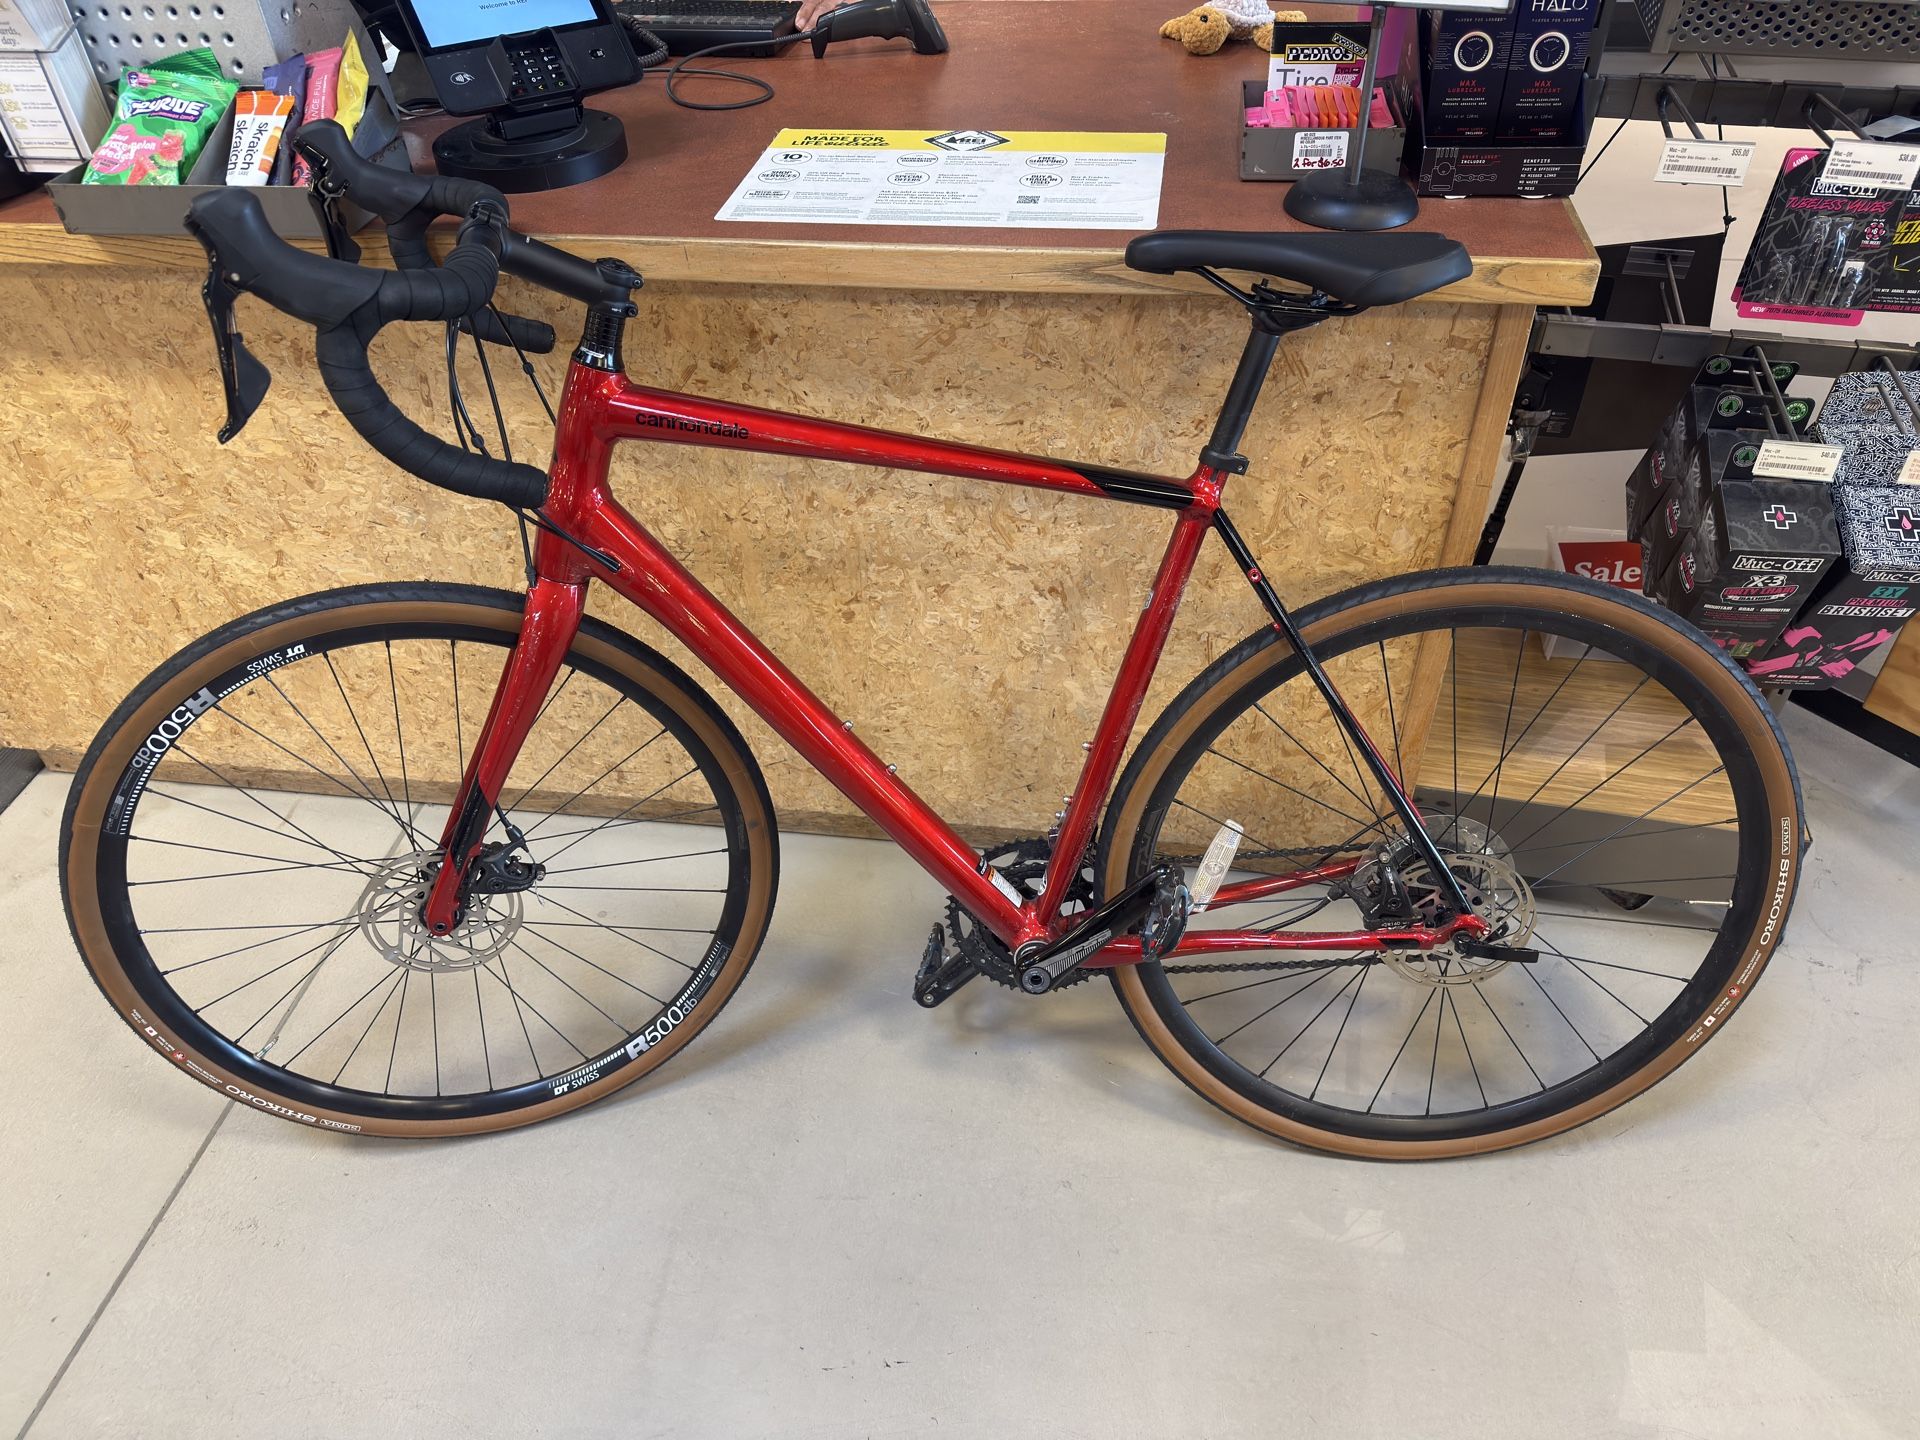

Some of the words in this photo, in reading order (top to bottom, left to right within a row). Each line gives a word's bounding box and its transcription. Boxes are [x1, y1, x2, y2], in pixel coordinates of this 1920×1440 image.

[1532, 0, 1588, 12] HALO
[1276, 68, 1329, 86] Tire
[1731, 148, 1750, 157] $55.00
[1786, 197, 1844, 211] TUBELESS
[1846, 199, 1894, 214] VALVES
[1782, 308, 1814, 316] MACHINED
[1815, 311, 1851, 319] ALUMINIUM
[636, 412, 749, 440] cannondale
[1821, 451, 1838, 459] $40.00
[1574, 560, 1641, 583] Sale
[1737, 557, 1820, 572] Muc-Off
[1747, 575, 1784, 587] X-3
[1725, 588, 1759, 596] DIRTY
[1875, 587, 1902, 597] 3X
[1849, 598, 1906, 607] PREMIUM
[1824, 606, 1878, 616] BRUSH
[1880, 607, 1910, 617] SET
[286, 644, 306, 658] DT
[247, 652, 283, 674] SWISS
[1782, 817, 1791, 855] SOMA
[1760, 858, 1790, 946] SHIKORO
[554, 1083, 570, 1095] DT
[572, 1070, 600, 1088] SWISS
[225, 1084, 317, 1123] SHIKORO
[320, 1119, 361, 1132] SOMA
